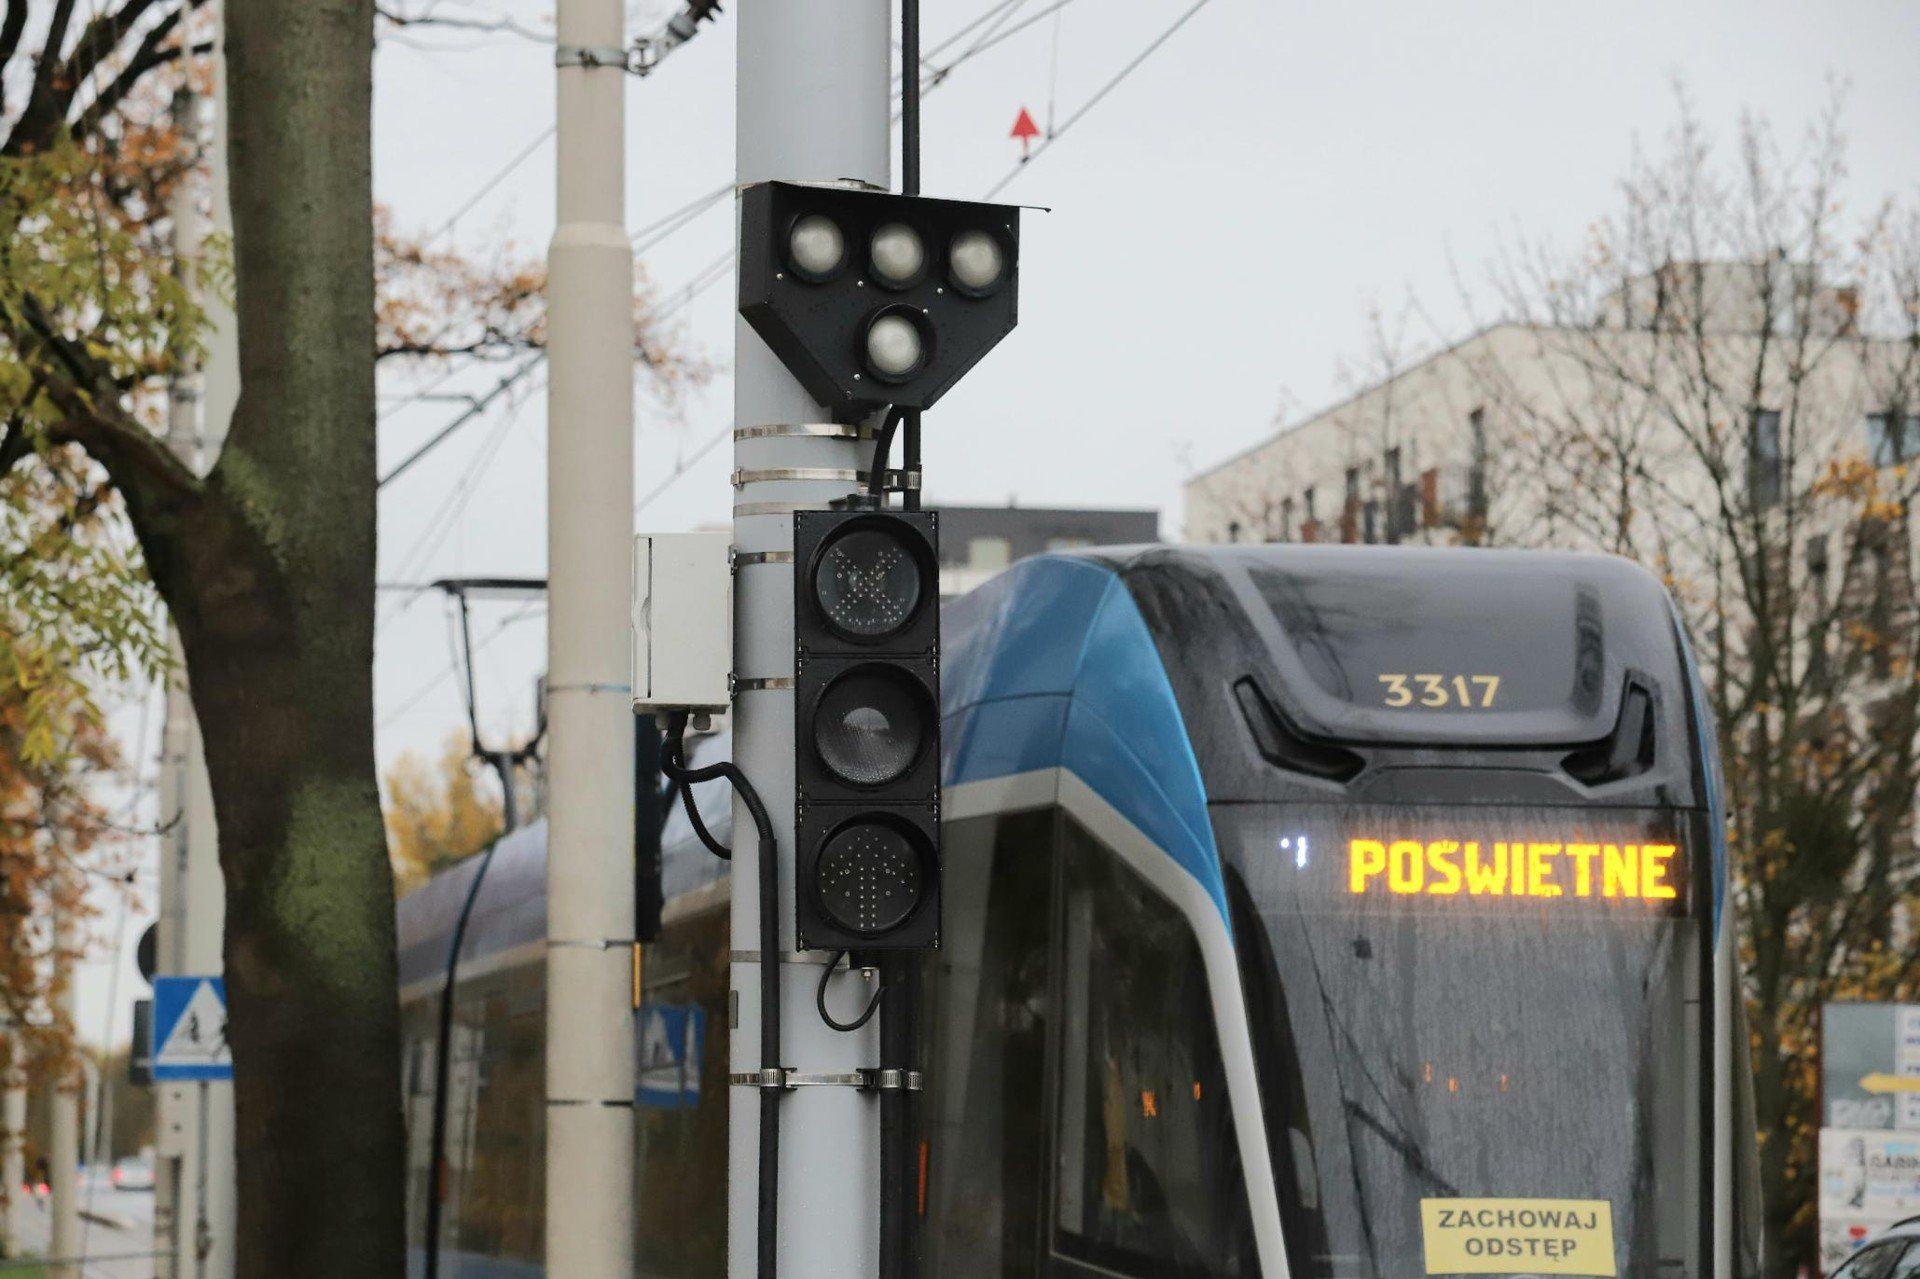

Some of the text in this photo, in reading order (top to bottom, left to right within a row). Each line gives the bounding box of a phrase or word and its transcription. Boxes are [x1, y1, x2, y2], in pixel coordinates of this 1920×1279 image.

[1378, 673, 1500, 707] 3317
[1438, 1209, 1597, 1230] ZACHOWAJ
[1465, 1237, 1577, 1262] ODSTĘP
